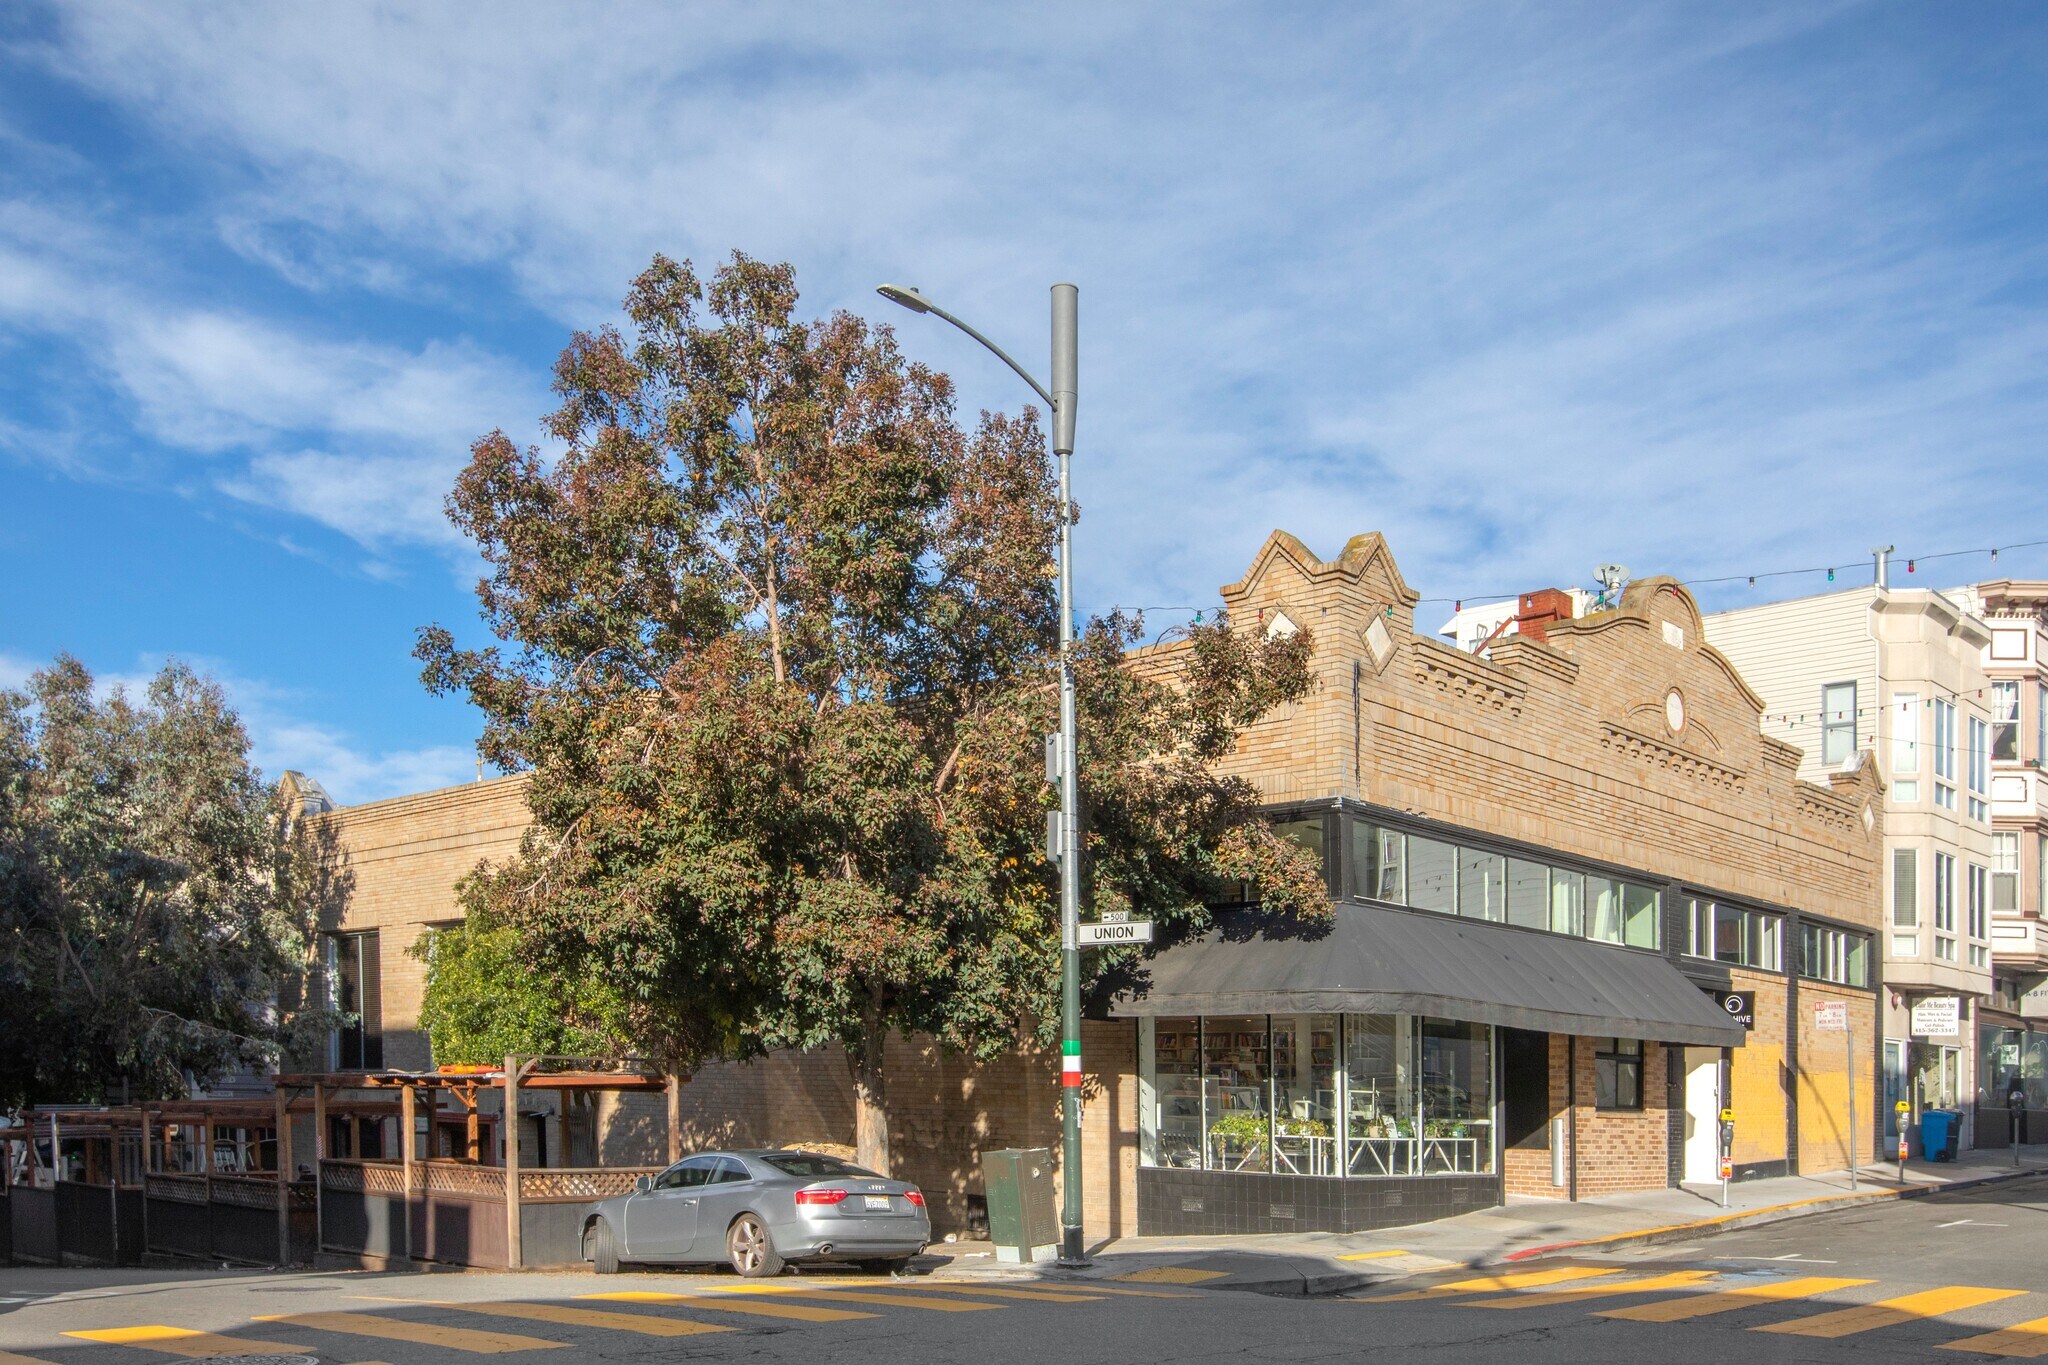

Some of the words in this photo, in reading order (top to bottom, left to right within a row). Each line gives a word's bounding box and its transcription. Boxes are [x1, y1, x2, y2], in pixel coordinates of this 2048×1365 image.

[1110, 912, 1124, 920] 500
[1094, 927, 1134, 939] UNION
[1815, 1002, 1824, 1010] NO
